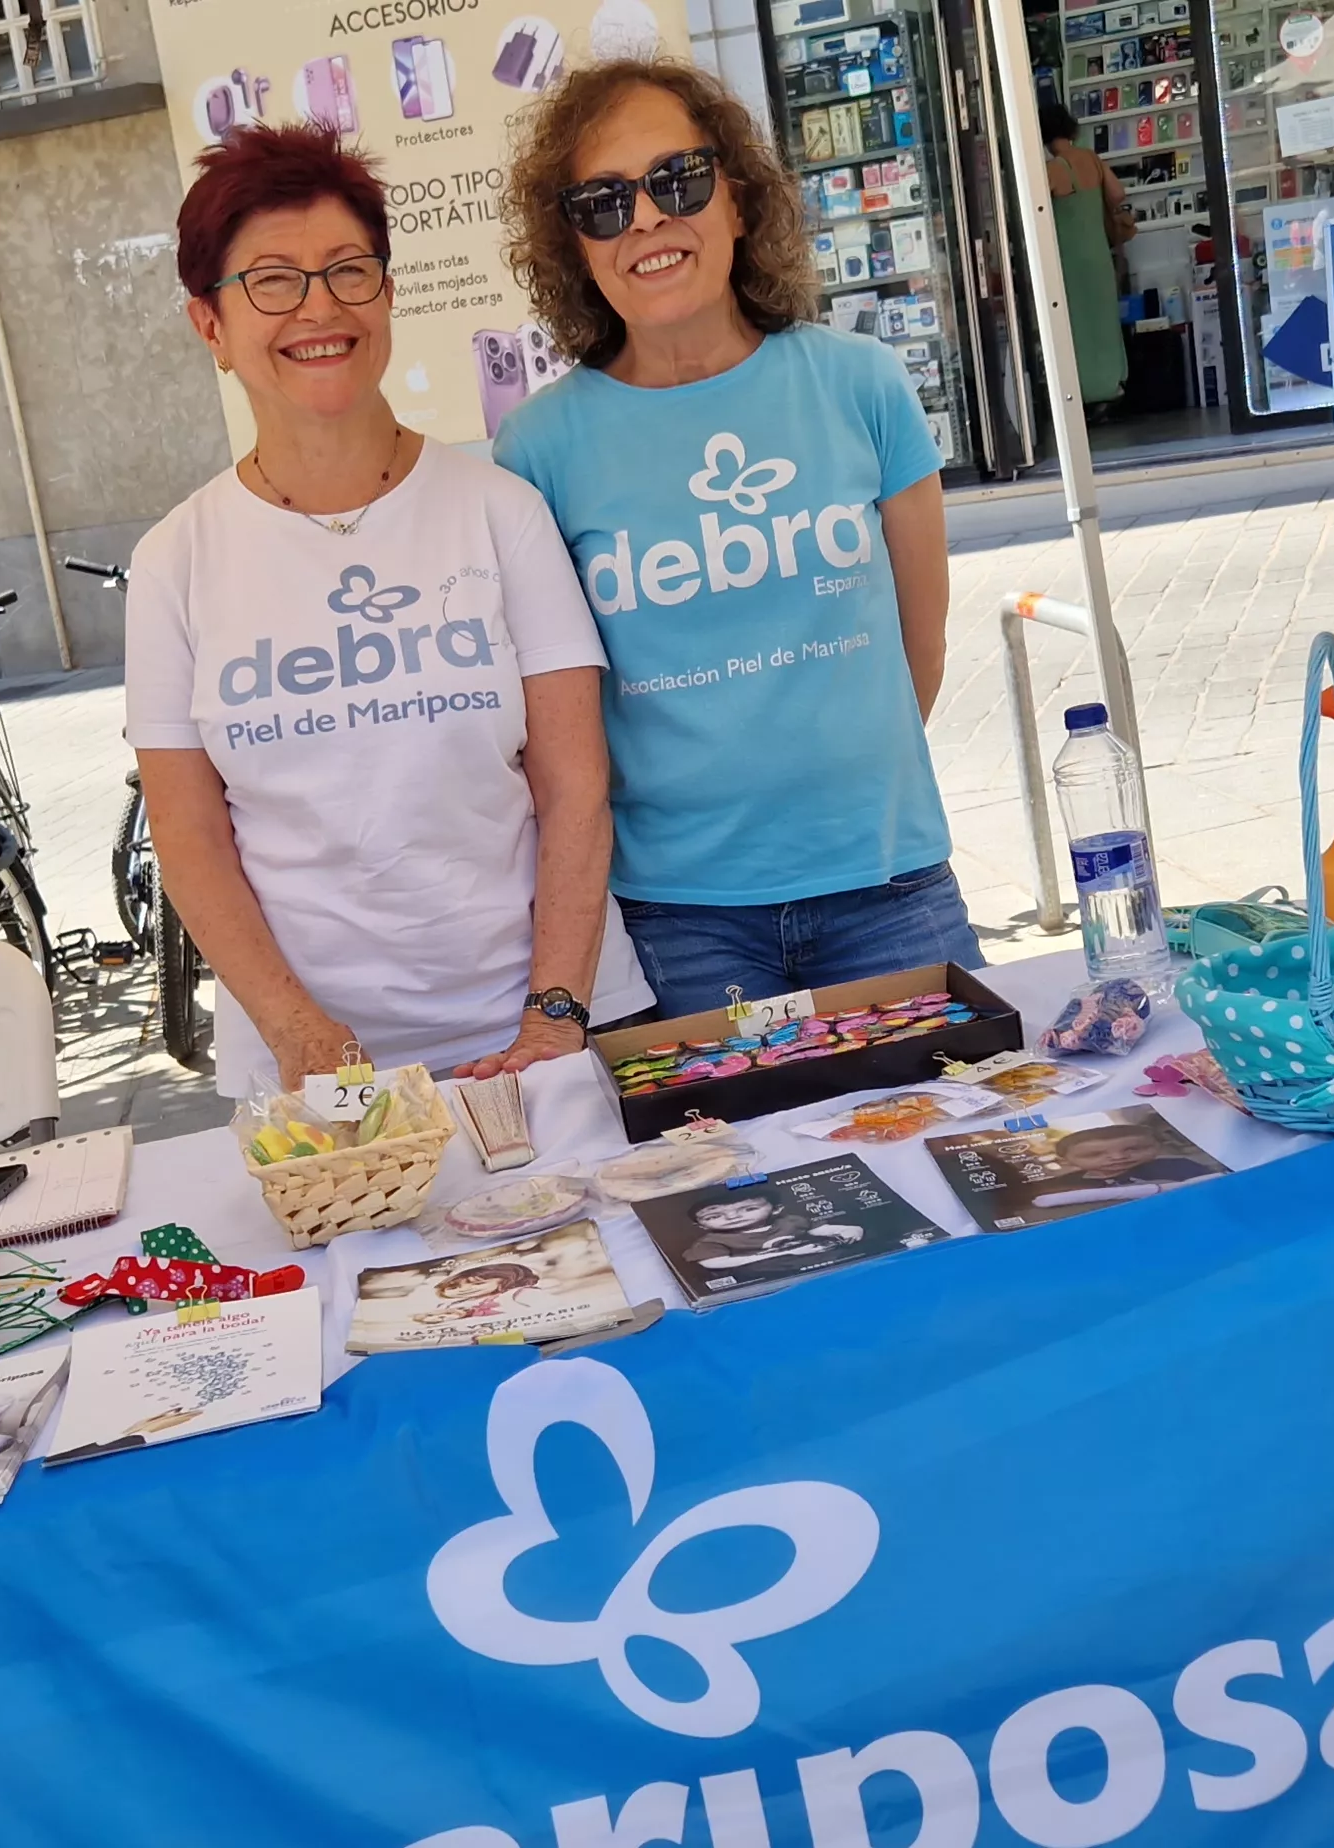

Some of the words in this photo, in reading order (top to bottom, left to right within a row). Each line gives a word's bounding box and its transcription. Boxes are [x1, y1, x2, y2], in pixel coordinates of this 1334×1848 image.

[395, 123, 473, 147] Protectores
[390, 178, 446, 206] ODO
[451, 168, 504, 195] TIPO
[388, 258, 436, 278] antallas
[438, 253, 470, 269] rotas
[438, 272, 488, 291] mojados
[391, 301, 447, 319] Conector
[451, 297, 467, 310] de
[470, 291, 503, 307] carga
[587, 503, 871, 616] debra
[439, 575, 457, 595] 30
[460, 566, 489, 579] años
[219, 618, 494, 706] debra
[620, 665, 720, 696] Asociación
[727, 652, 763, 679] Piel
[770, 647, 796, 668] de
[802, 631, 870, 662] Mariposa
[225, 713, 283, 750] Piel
[294, 709, 336, 736] de
[347, 690, 502, 729] Mariposa
[762, 1006, 774, 1028] 2
[334, 1086, 349, 1108] 2
[358, 1085, 375, 1107] €
[678, 1132, 696, 1141] 2
[162, 1329, 197, 1343] para
[202, 1324, 217, 1334] la
[221, 1315, 266, 1330] boda?
[218, 1311, 250, 1324] algo
